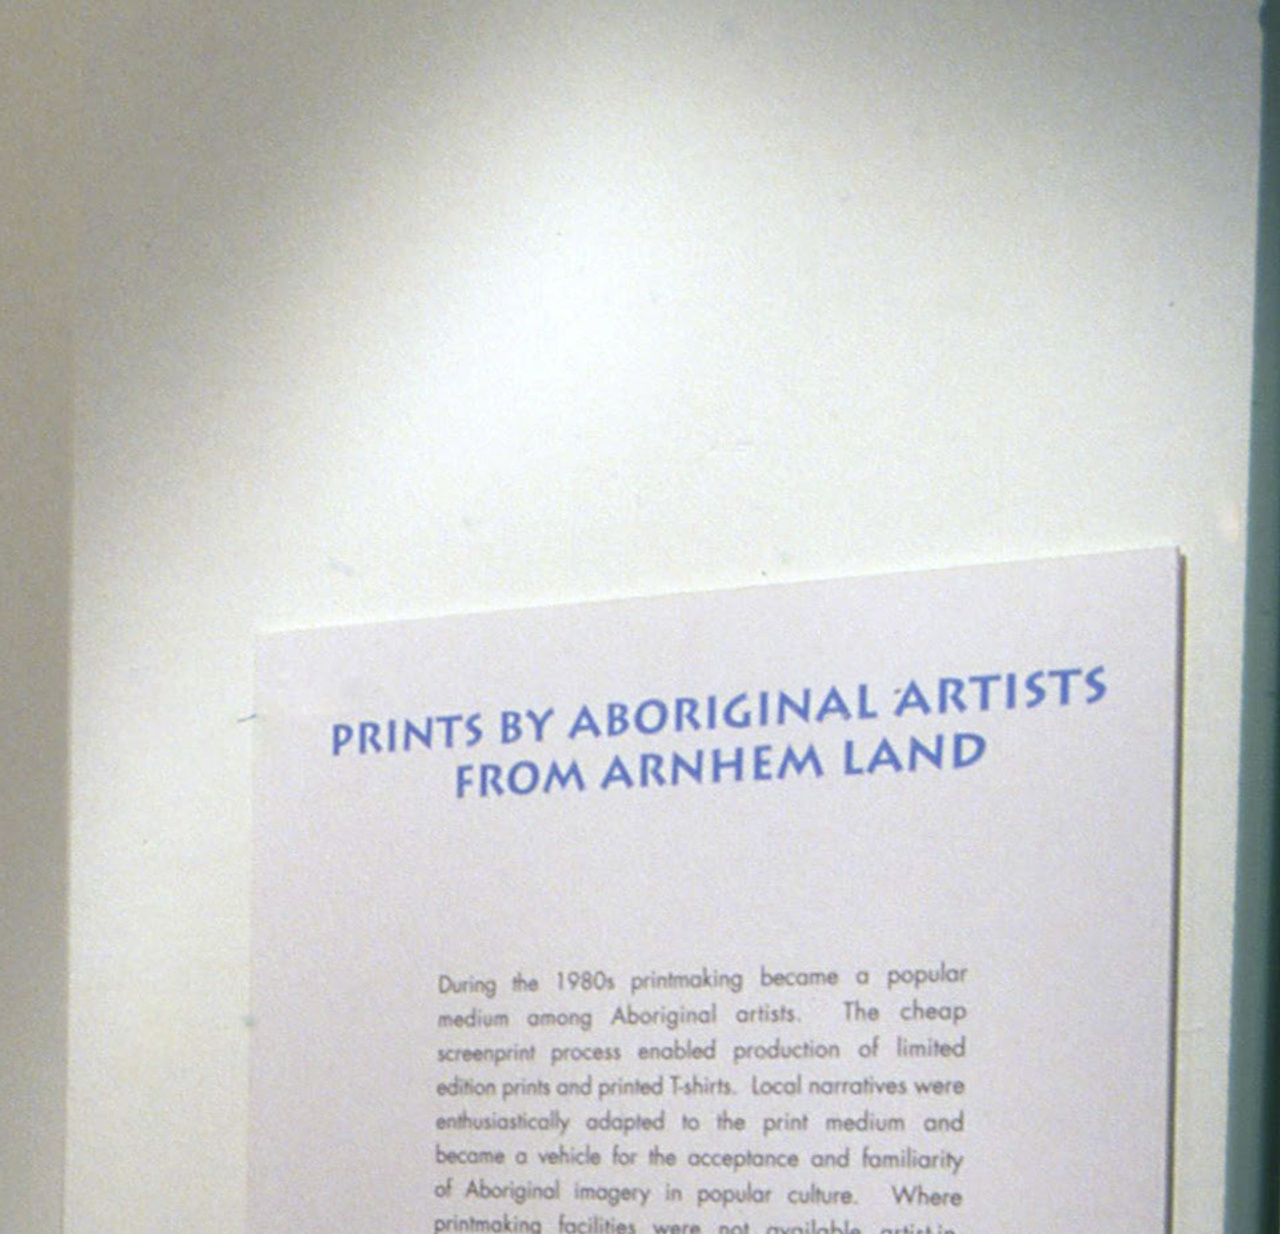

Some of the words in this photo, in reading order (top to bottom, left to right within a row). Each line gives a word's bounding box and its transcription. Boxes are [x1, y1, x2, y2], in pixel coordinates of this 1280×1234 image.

[333, 713, 482, 756] PRINTS
[501, 708, 554, 744] BY
[568, 684, 877, 739] ABORIGINAL
[894, 666, 1106, 716] ARTISTS
[457, 761, 585, 798] FROM
[601, 745, 823, 789] ARNHEM
[845, 733, 986, 775] LAND
[439, 974, 497, 999] During
[512, 972, 539, 992] the
[558, 970, 615, 991] 1980s
[631, 967, 743, 995] printmaking
[760, 965, 839, 987] became
[887, 961, 968, 989] popular
[438, 1008, 509, 1027] medium
[527, 1013, 592, 1031] among
[611, 1003, 717, 1030] Aboriginal
[736, 1005, 800, 1023] artists.
[843, 1000, 880, 1021] The
[900, 999, 967, 1024] cheap
[438, 1046, 536, 1065] screenprint
[551, 1047, 621, 1065] process
[638, 1039, 716, 1060] enabled
[733, 1038, 840, 1064] production
[858, 1035, 879, 1058] of
[897, 1035, 966, 1057] limited
[436, 1076, 496, 1096] edition
[502, 1080, 550, 1100] prints
[556, 1075, 592, 1096] and
[599, 1075, 663, 1100] printed
[670, 1075, 738, 1095] T-shirts.
[752, 1074, 801, 1095] Local
[809, 1076, 907, 1095] narratives
[914, 1080, 965, 1095] were
[436, 1110, 570, 1135] enthusiastically
[586, 1110, 665, 1135] adapted
[717, 1110, 746, 1131] the
[763, 1113, 808, 1136] print
[826, 1110, 905, 1132] medium
[924, 1110, 964, 1132] and
[435, 1144, 505, 1164] became
[538, 1145, 601, 1165] vehicle
[612, 1144, 637, 1166] for
[649, 1145, 677, 1166] the
[688, 1150, 799, 1171] acceptance
[811, 1147, 850, 1168] and
[862, 1146, 964, 1175] familiarity
[465, 1179, 560, 1205] Aboriginal
[575, 1184, 651, 1207] imagery
[697, 1182, 772, 1207] popular
[787, 1183, 857, 1205] culture.
[892, 1184, 963, 1207] Where
